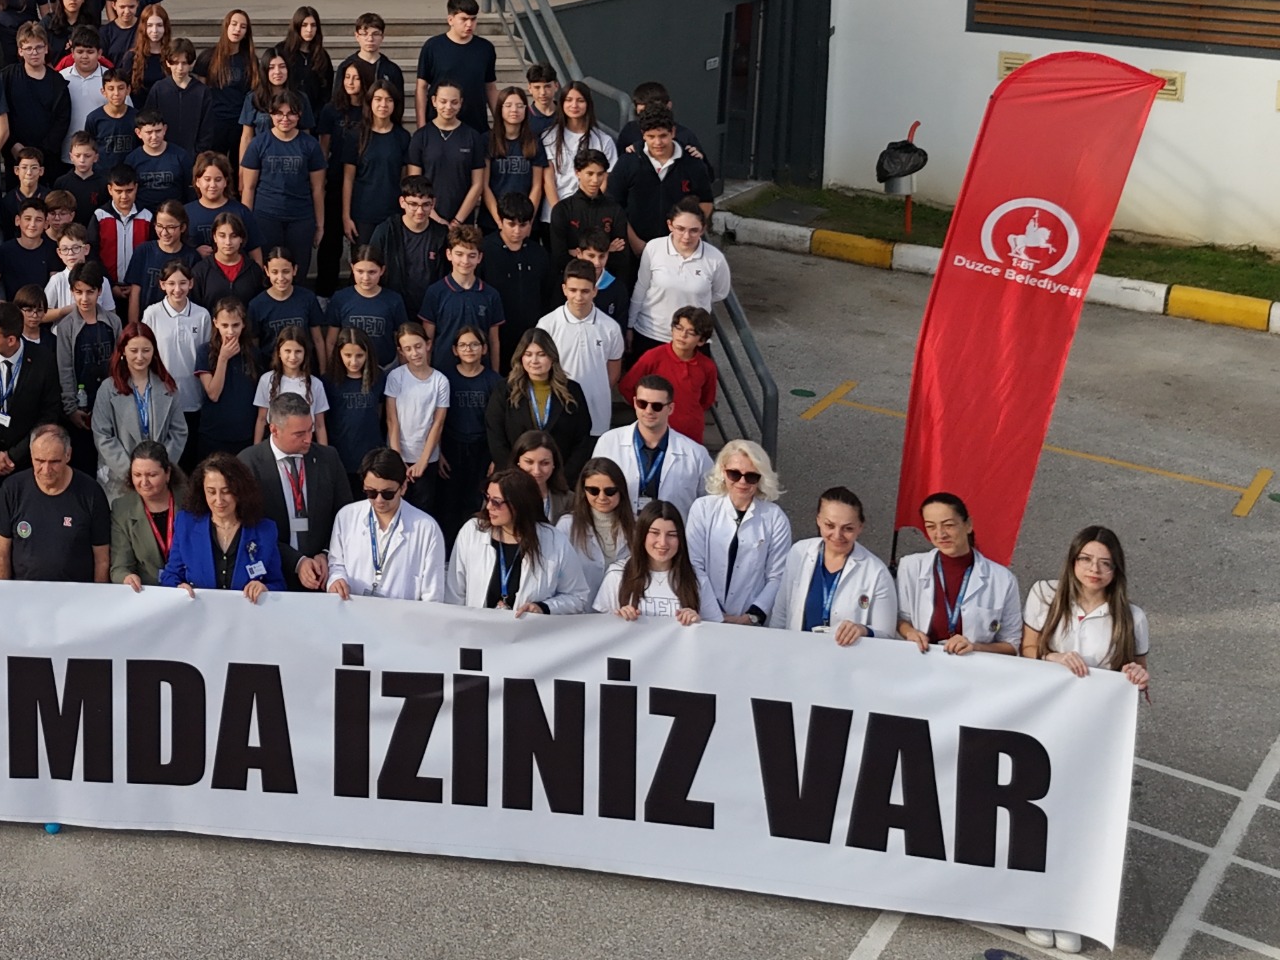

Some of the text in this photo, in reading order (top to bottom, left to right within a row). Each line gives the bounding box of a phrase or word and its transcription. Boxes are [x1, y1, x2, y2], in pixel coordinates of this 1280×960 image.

[105, 134, 132, 153] TED
[268, 155, 303, 174] TED
[495, 155, 530, 174] TED
[140, 171, 174, 189] TED
[1004, 268, 1082, 298] Belediyesi
[349, 315, 386, 337] TED
[343, 392, 375, 409] TED
[456, 391, 486, 408] TED
[333, 643, 717, 830] İZİNİZ
[751, 697, 1052, 873] VAR
